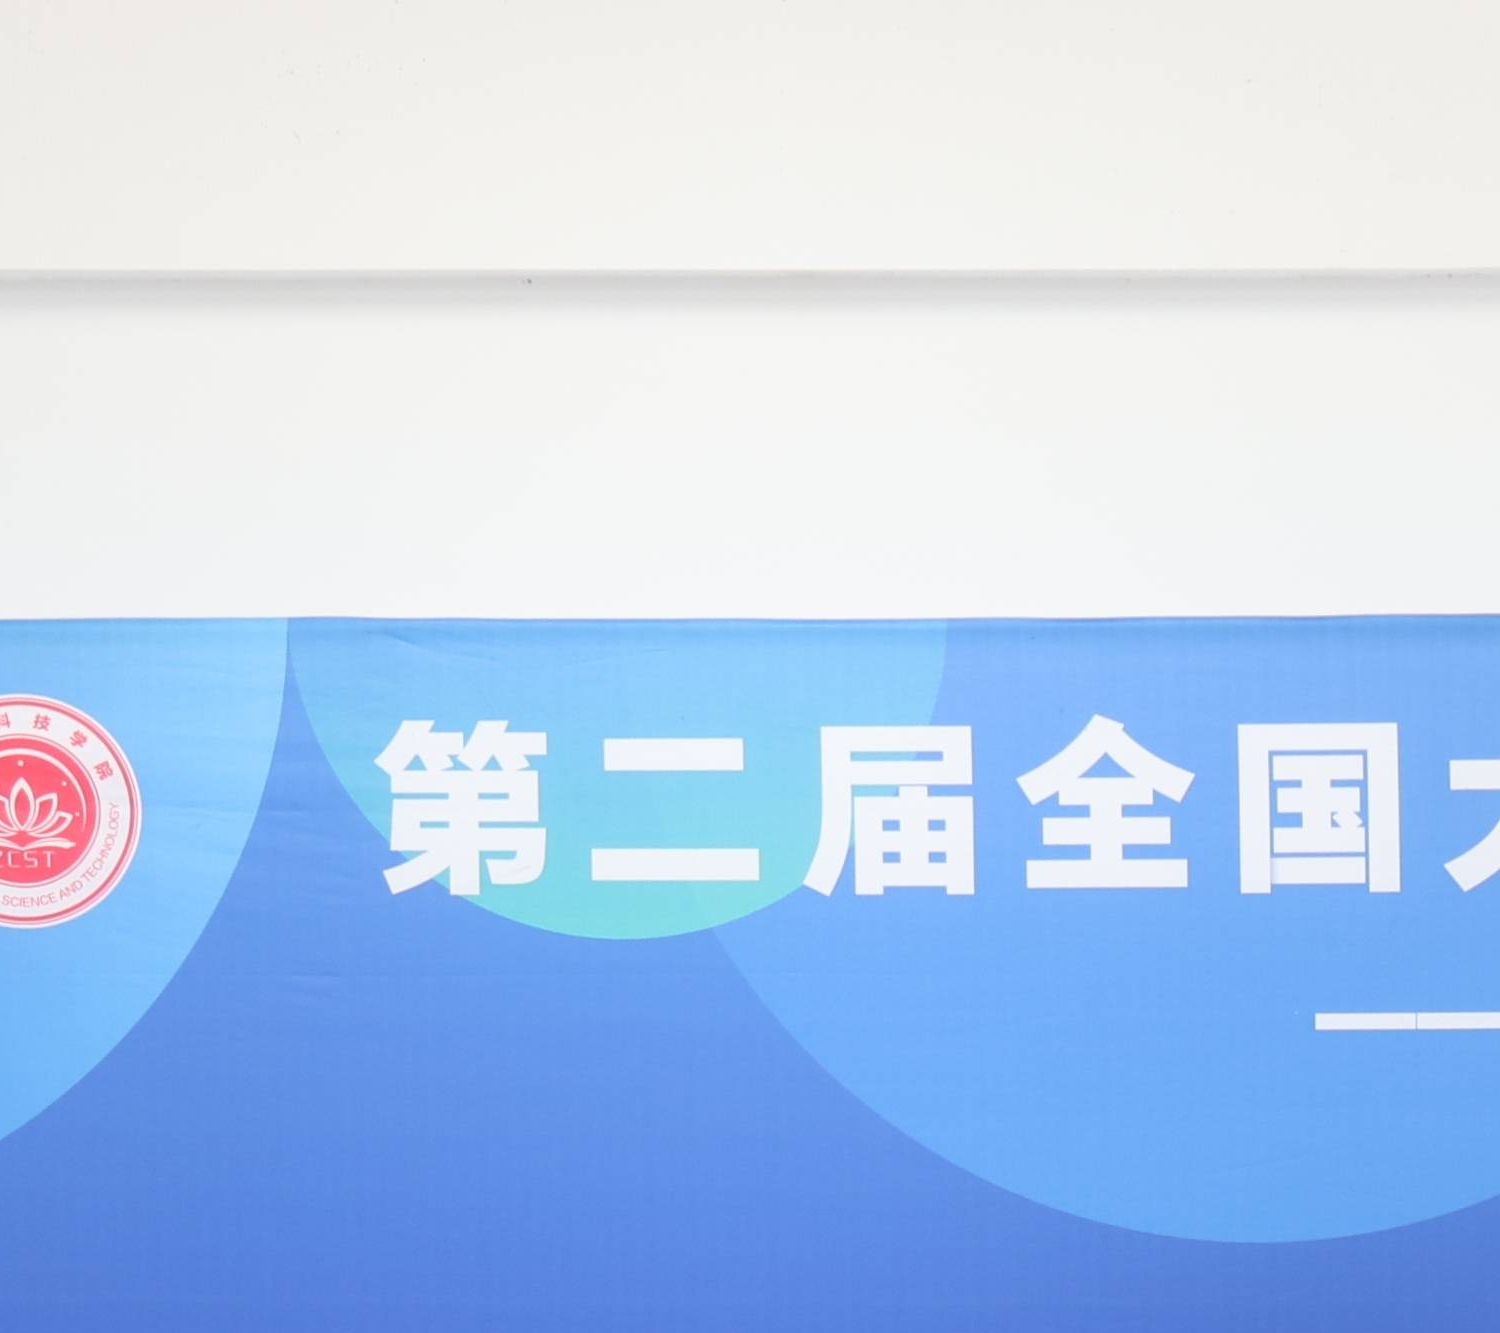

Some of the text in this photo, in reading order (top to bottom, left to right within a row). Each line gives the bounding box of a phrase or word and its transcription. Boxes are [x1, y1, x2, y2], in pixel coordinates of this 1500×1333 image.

[2, 895, 57, 909] SCIENCE
[59, 880, 84, 901] AND
[81, 802, 121, 883] TECHNOLOGY
